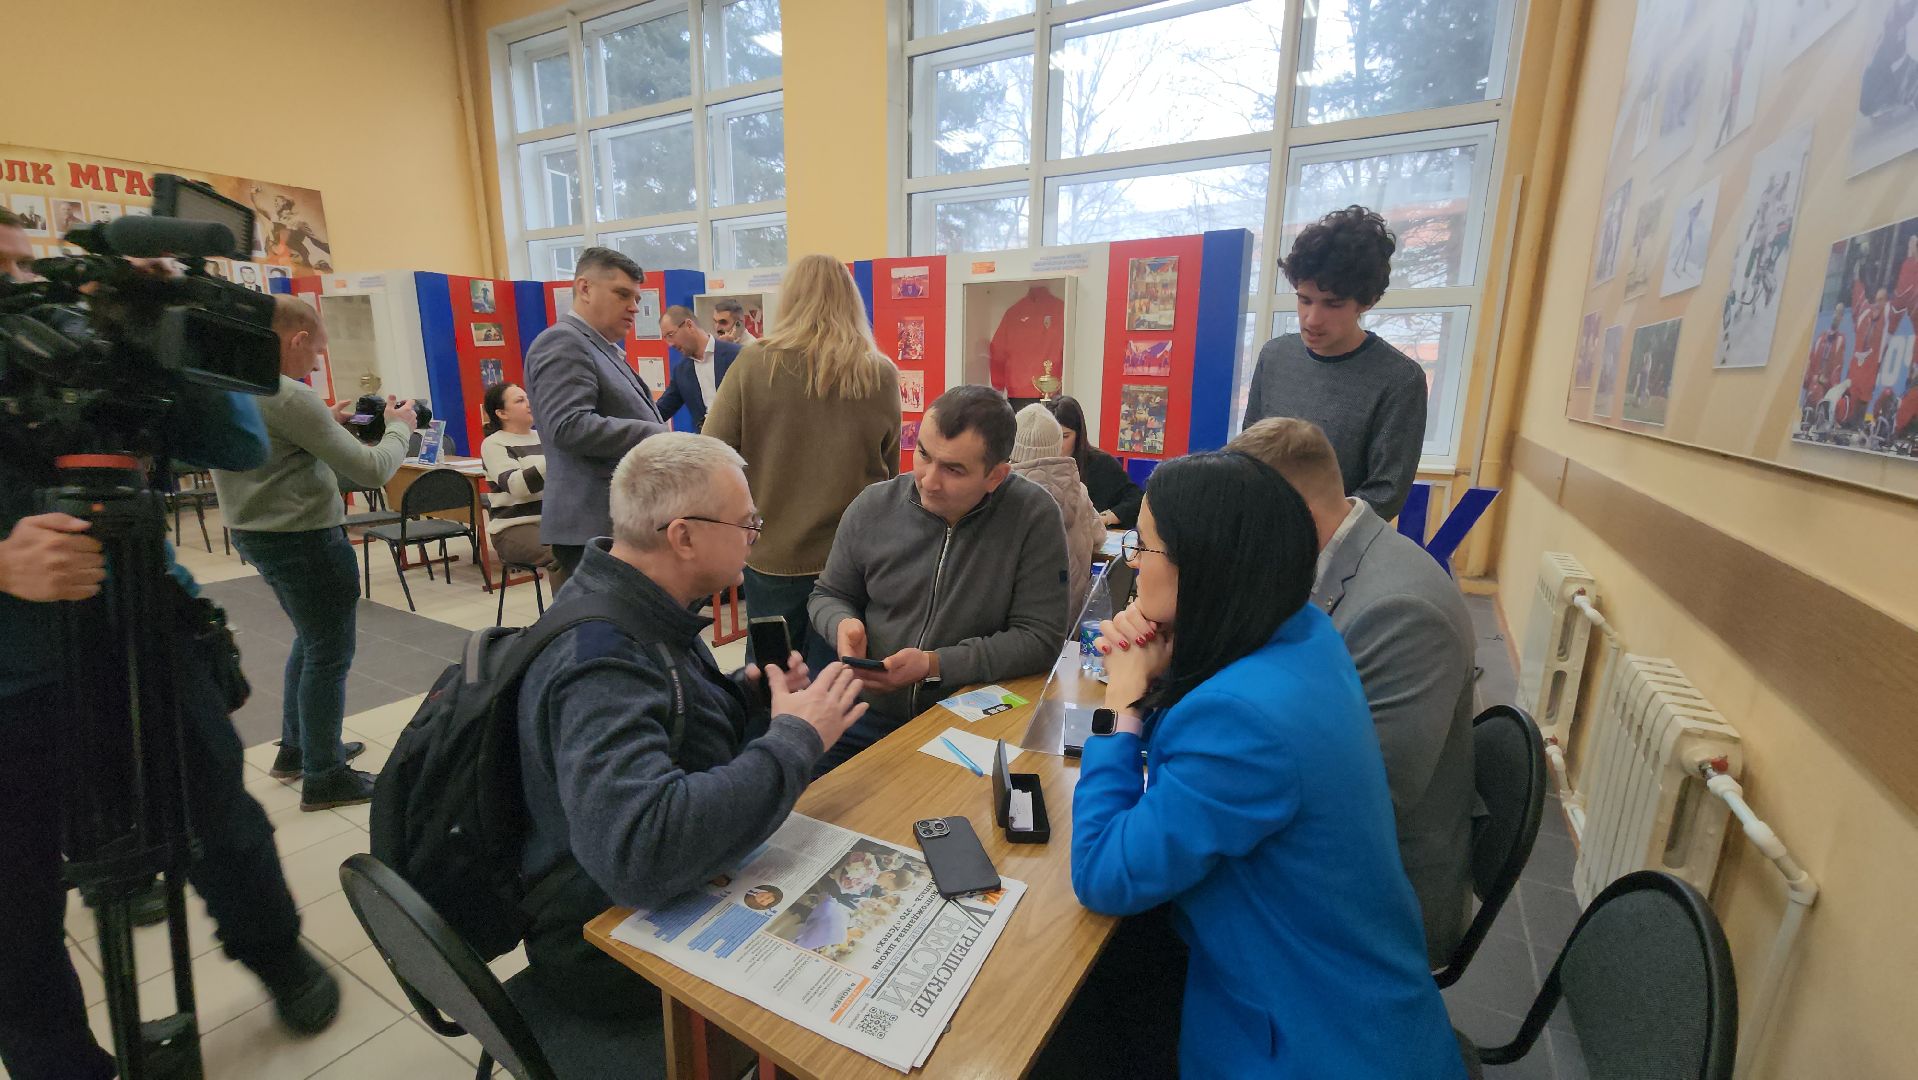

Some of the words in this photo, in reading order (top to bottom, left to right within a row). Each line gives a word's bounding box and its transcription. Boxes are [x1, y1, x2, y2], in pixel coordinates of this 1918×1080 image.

[0, 158, 56, 186] ЛК
[67, 162, 156, 197] МГА
[894, 889, 939, 944] долгожданная
[899, 907, 914, 921] это
[871, 942, 897, 971] школа
[876, 912, 969, 1011] ВЕСТИ
[910, 898, 997, 1018] УГРЕШСКИЕ
